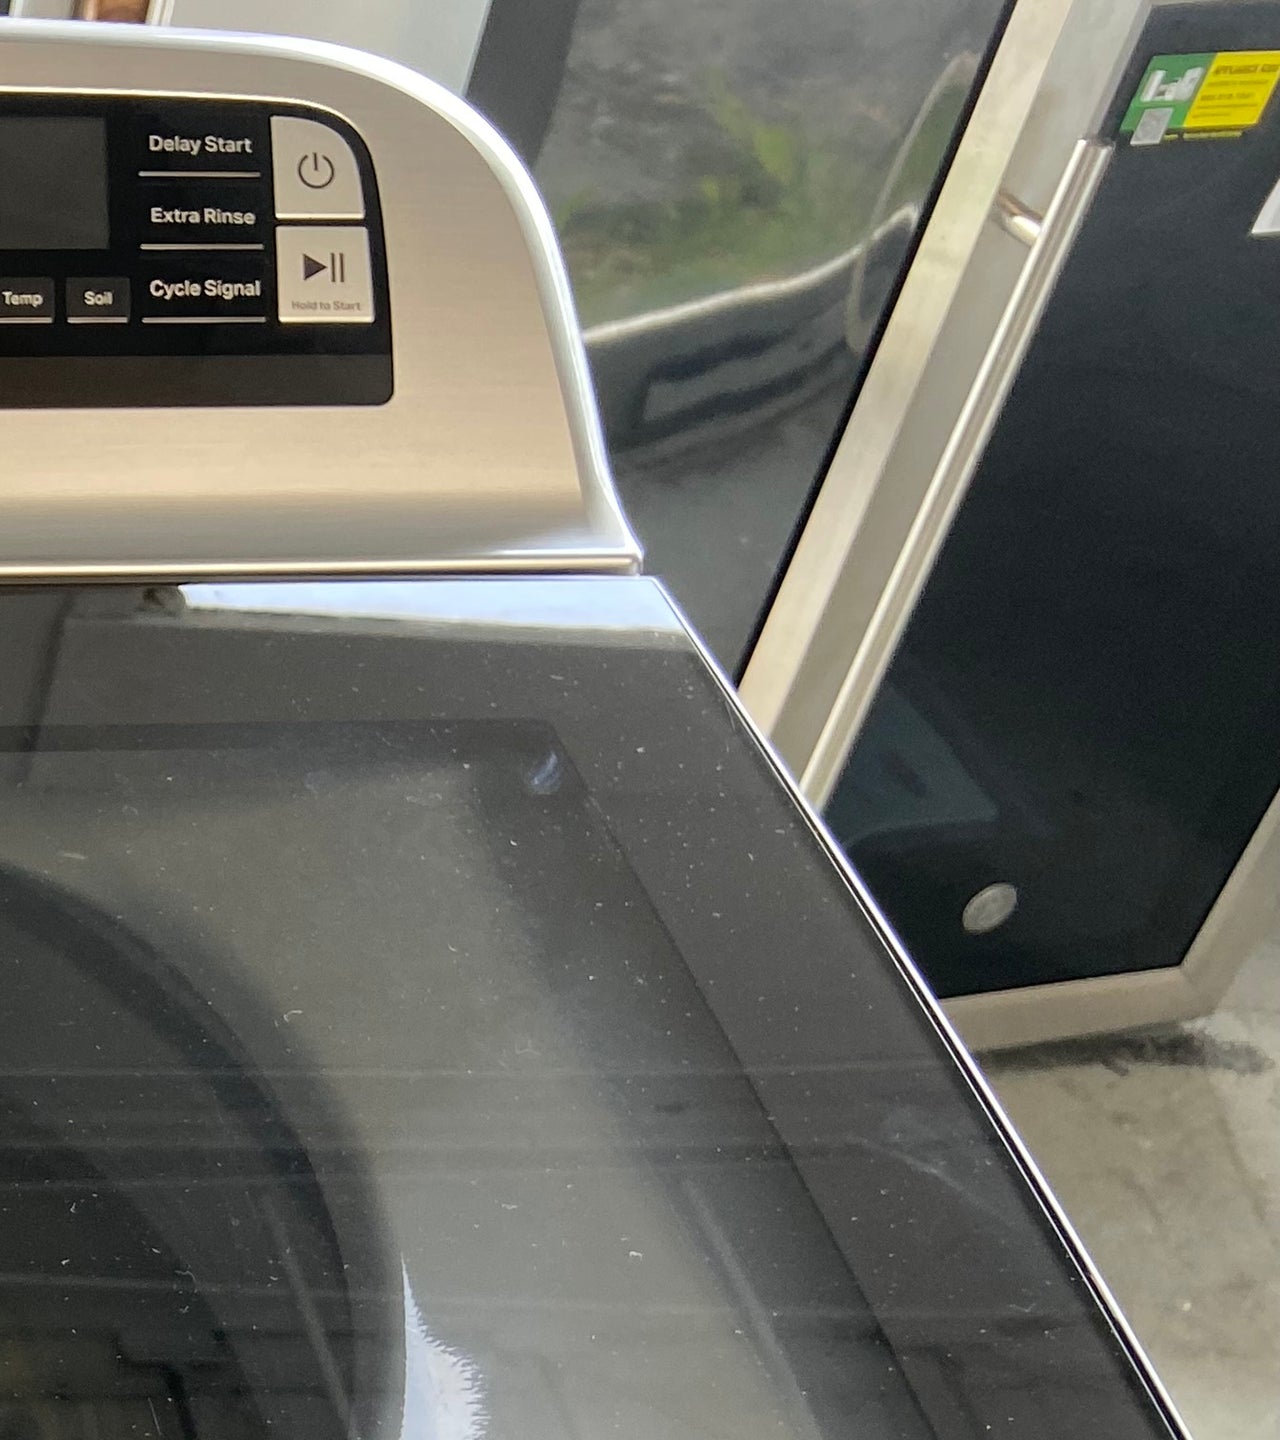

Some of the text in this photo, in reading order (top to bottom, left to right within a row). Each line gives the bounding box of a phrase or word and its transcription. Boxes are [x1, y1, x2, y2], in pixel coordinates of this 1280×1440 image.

[148, 134, 253, 156] Delay Start
[150, 206, 257, 226] Extra Rinse
[0, 290, 44, 308] Temp
[83, 290, 114, 307] Soil
[149, 278, 261, 300] Cycle Signal
